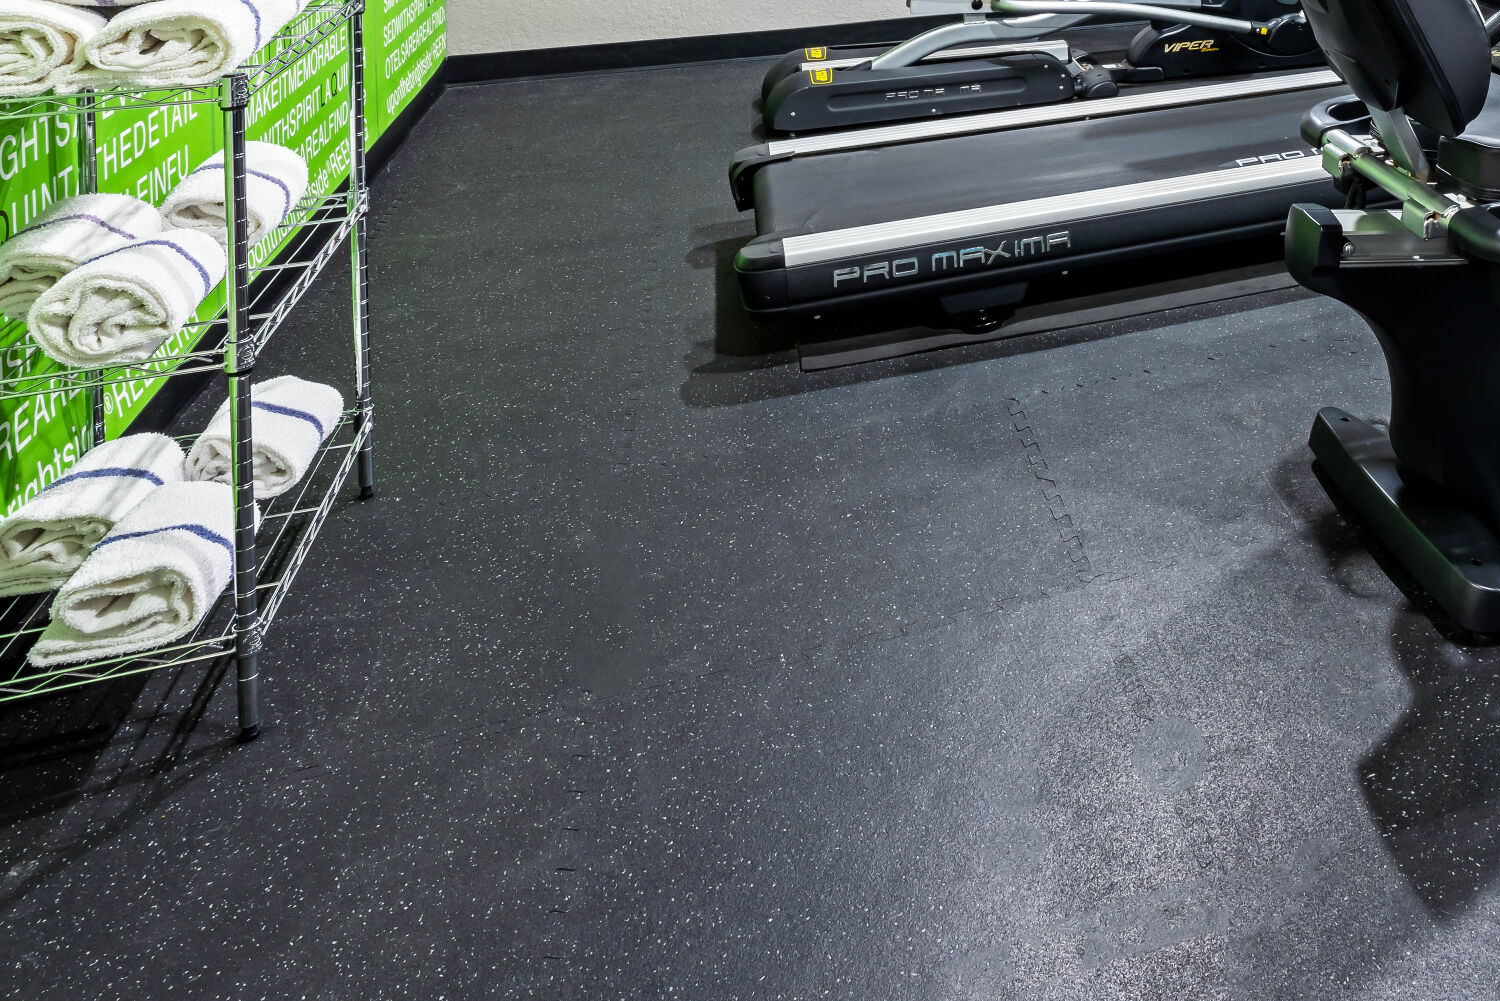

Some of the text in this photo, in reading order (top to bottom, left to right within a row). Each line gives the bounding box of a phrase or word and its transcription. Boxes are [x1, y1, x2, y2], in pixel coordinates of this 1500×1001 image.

[1164, 40, 1214, 53] VIPER
[1235, 150, 1304, 167] PRO
[833, 230, 1071, 288] PRO MAXIMA
